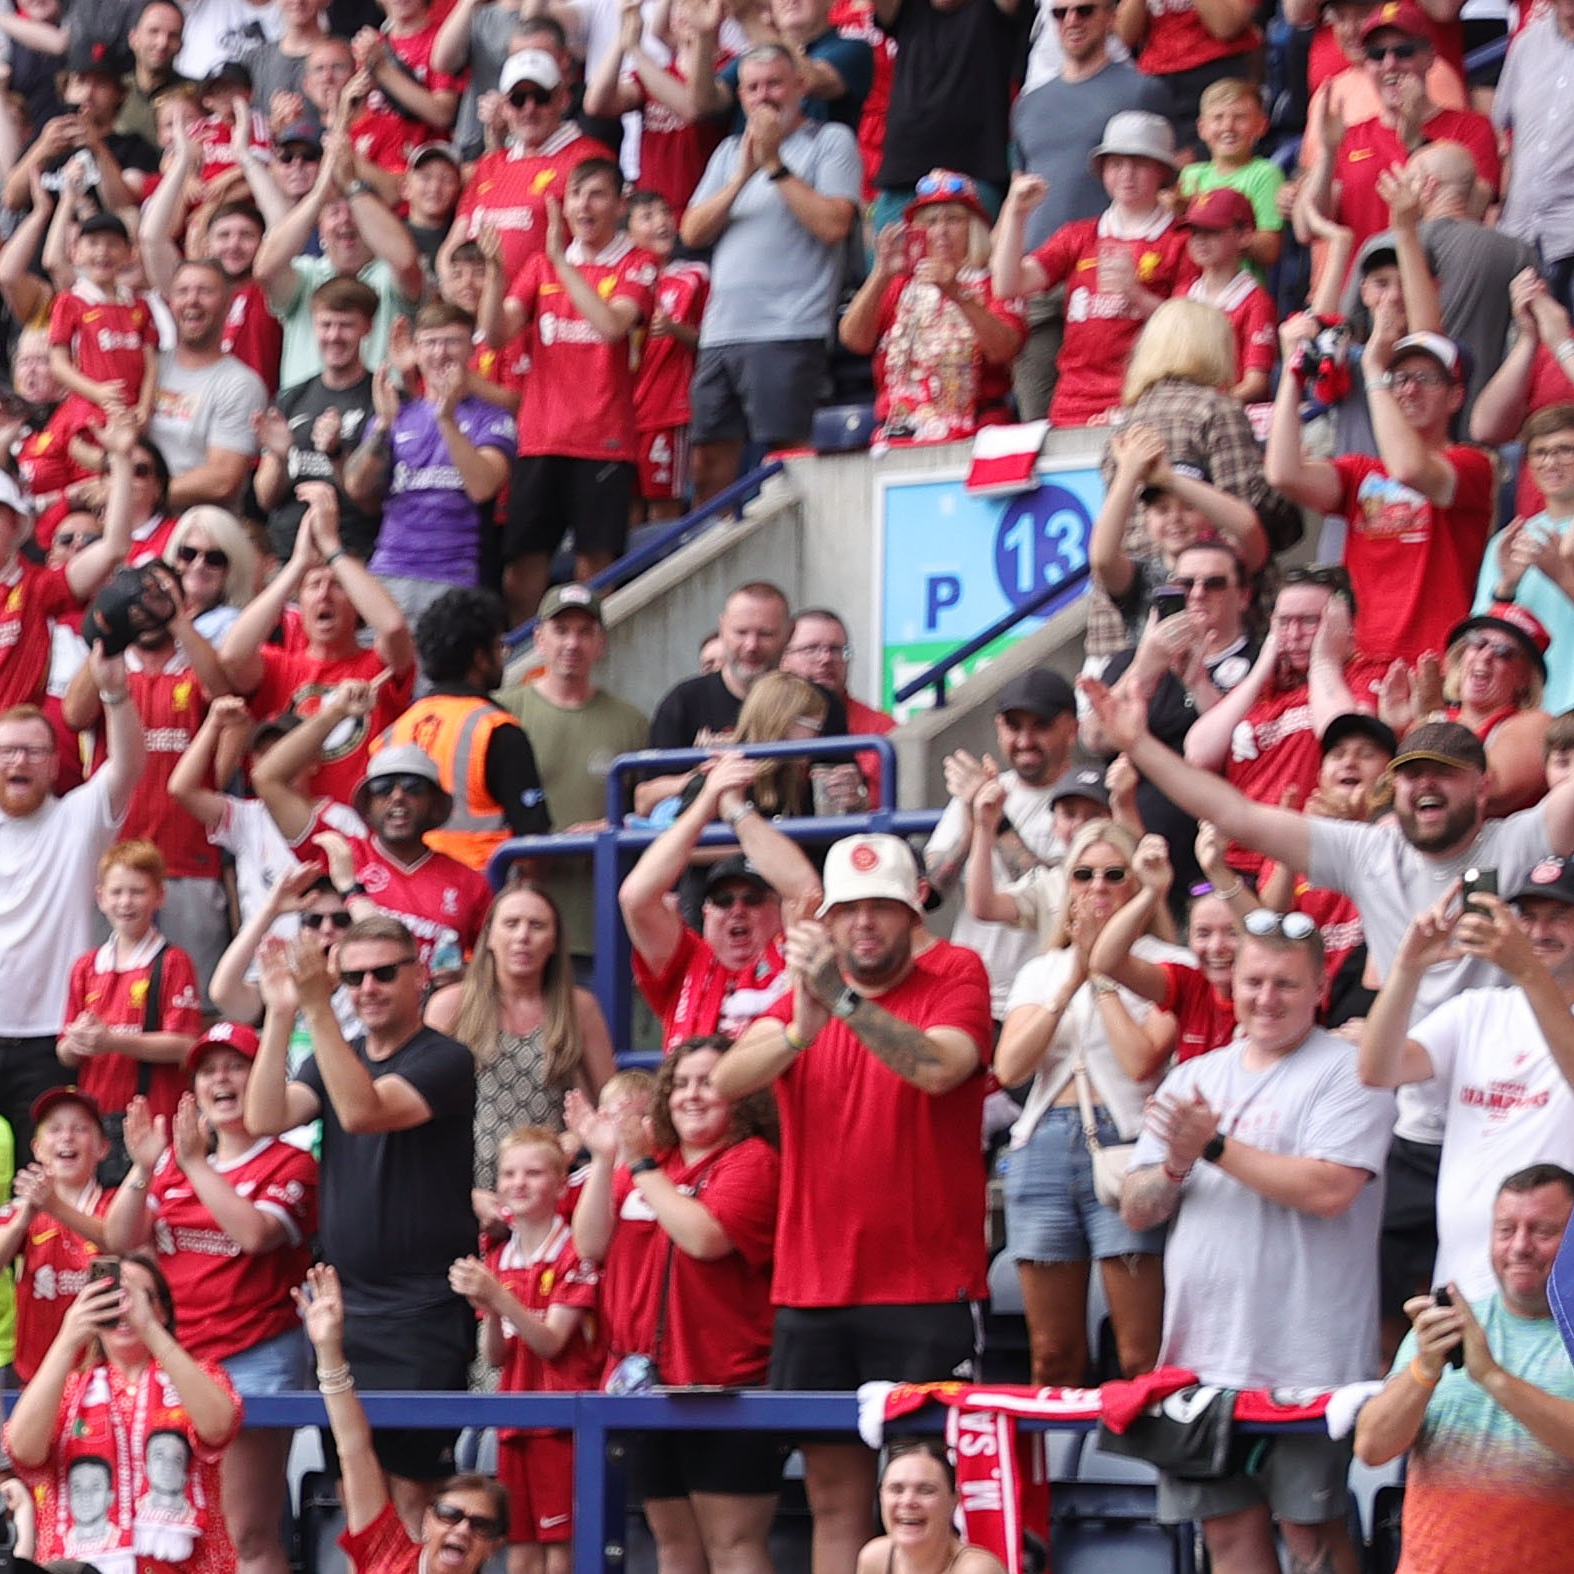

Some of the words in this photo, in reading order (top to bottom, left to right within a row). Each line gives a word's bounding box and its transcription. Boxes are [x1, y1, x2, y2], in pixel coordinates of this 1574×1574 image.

[1003, 510, 1086, 594] 13
[926, 574, 961, 630] P
[959, 1412, 998, 1457] SA
